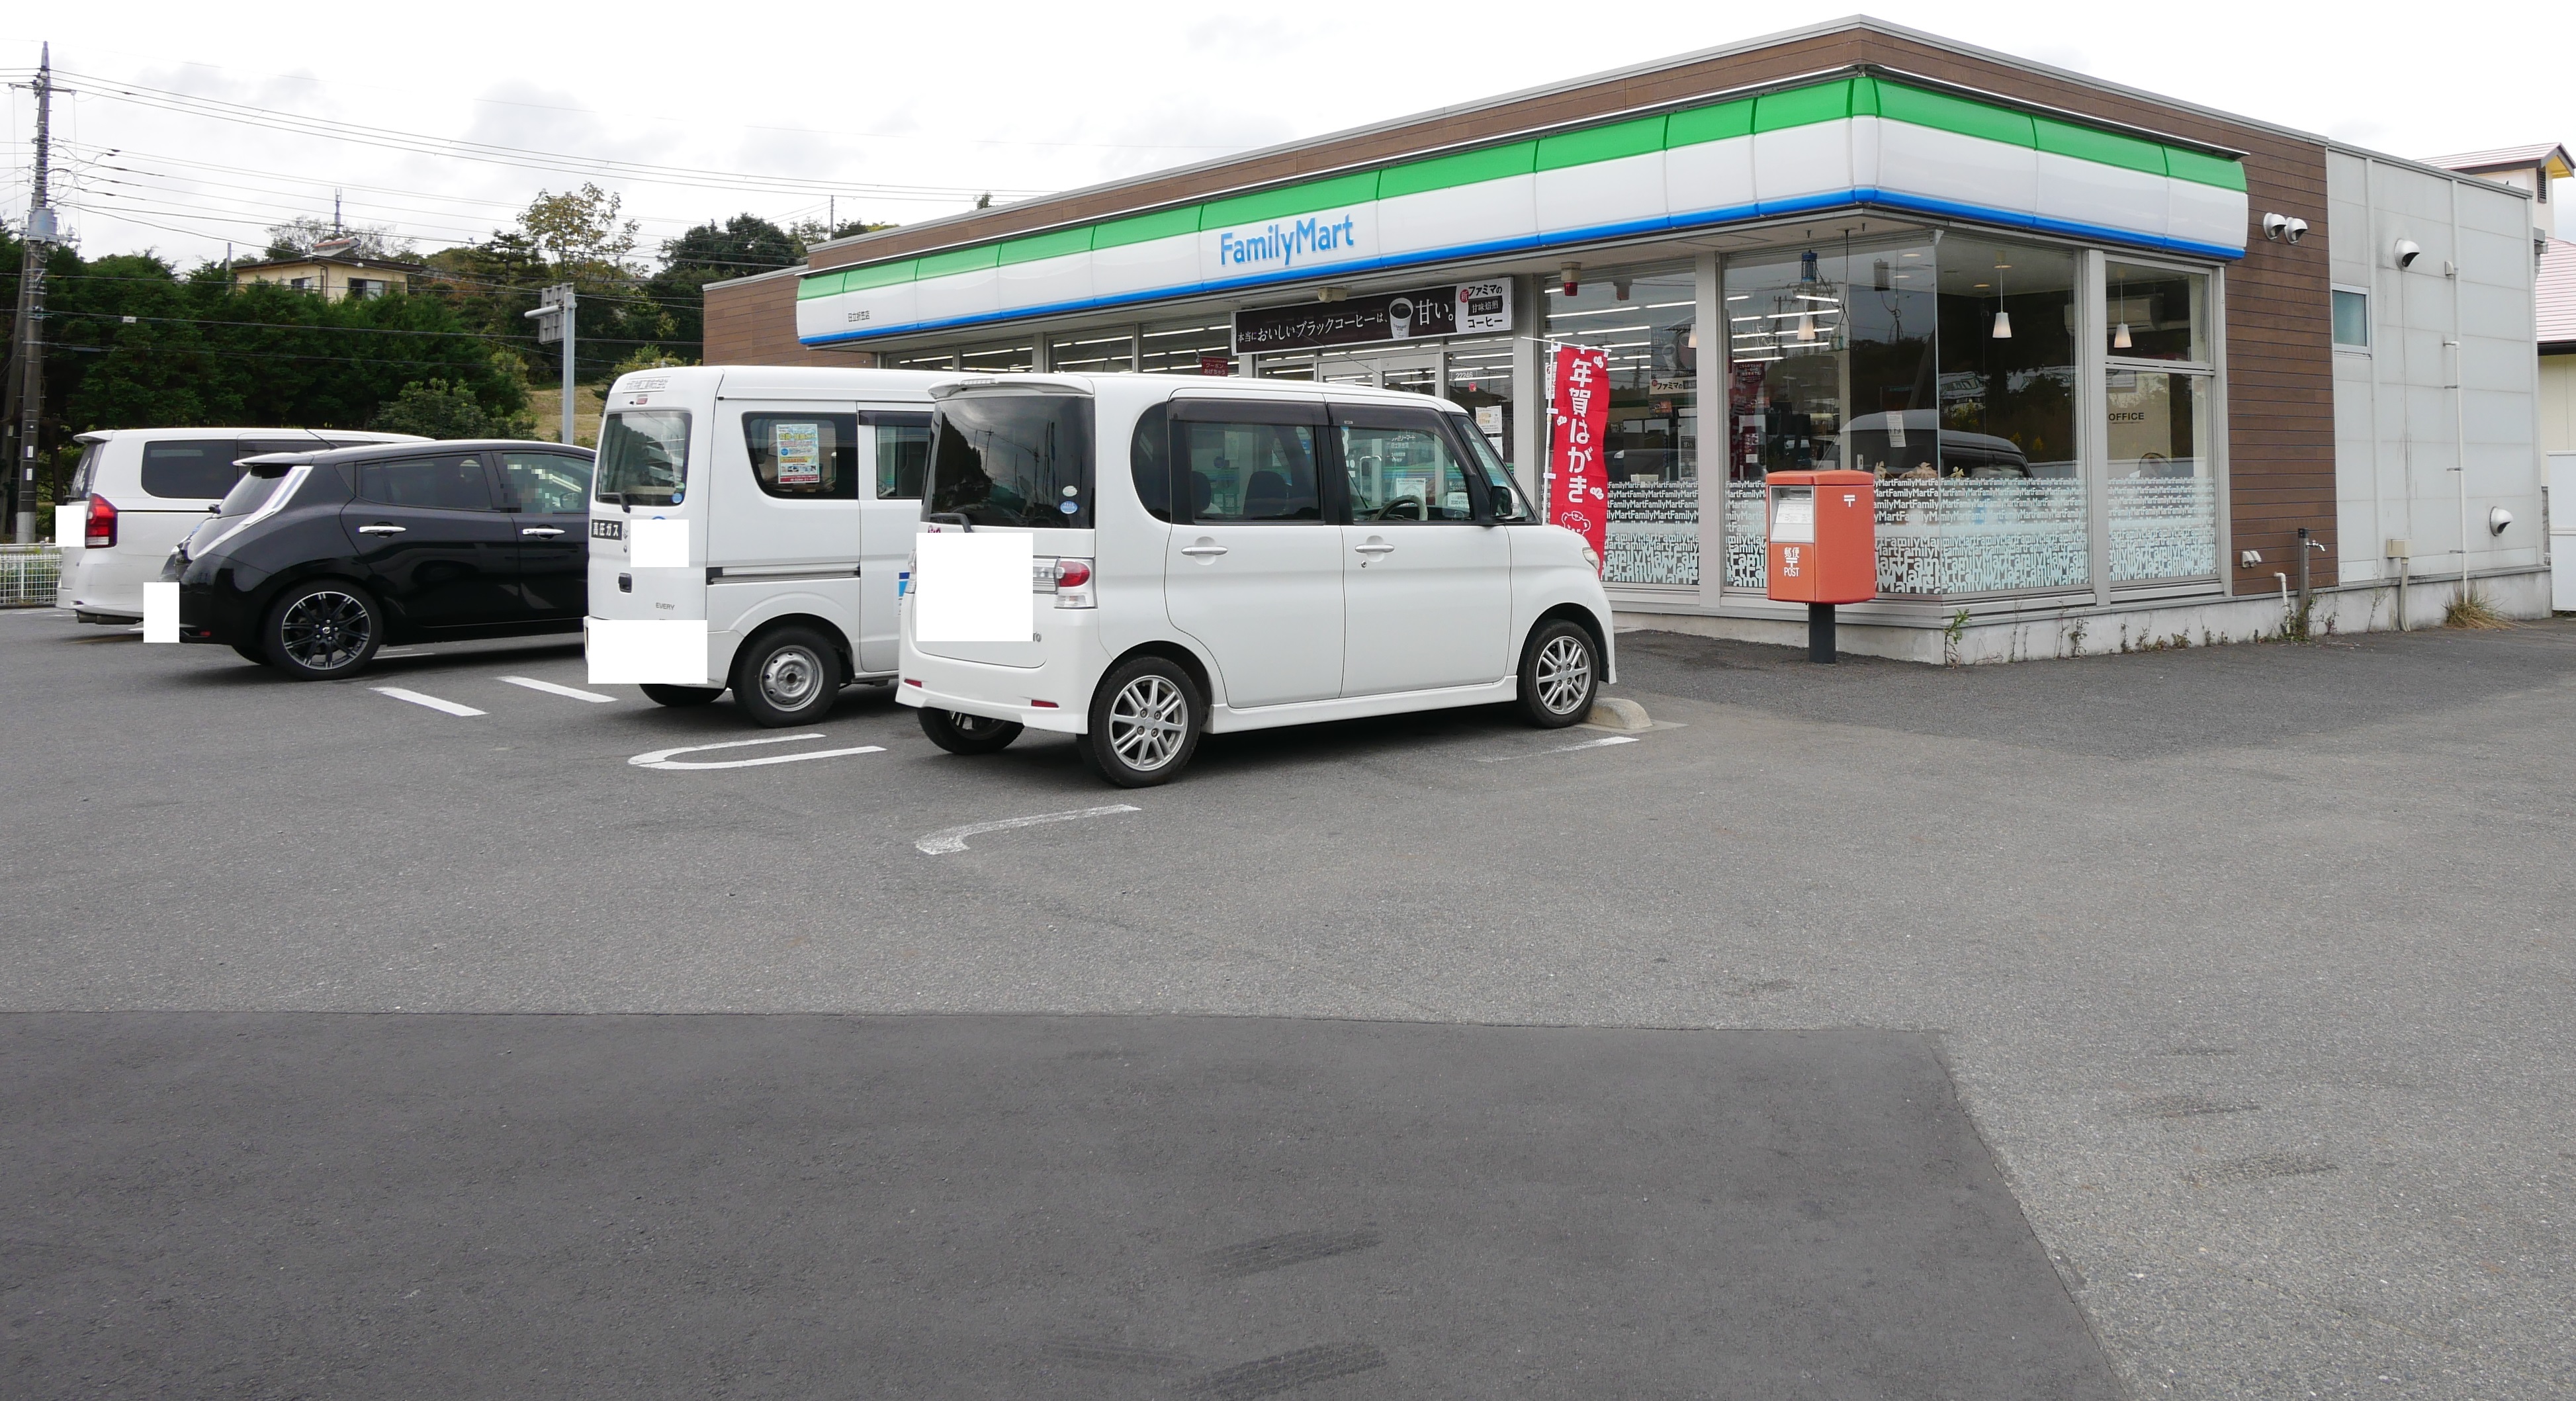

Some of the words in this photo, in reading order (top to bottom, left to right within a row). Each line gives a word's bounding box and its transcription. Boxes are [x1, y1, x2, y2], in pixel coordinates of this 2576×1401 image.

[1220, 214, 1354, 266] FamilyMart
[1468, 285, 1503, 296] ファミマの
[1237, 313, 1388, 343] 本当においしいブラックコーヒーは、
[1415, 298, 1454, 326] 甘い。
[1467, 316, 1503, 328] コーヒー
[1657, 381, 1683, 390] ファミマの
[2108, 412, 2145, 421] OFFICE
[1567, 358, 1593, 503] 年賀はがき
[593, 521, 619, 537] 高圧ガス
[1784, 547, 1799, 559] 郵便
[1783, 567, 1800, 577] POST
